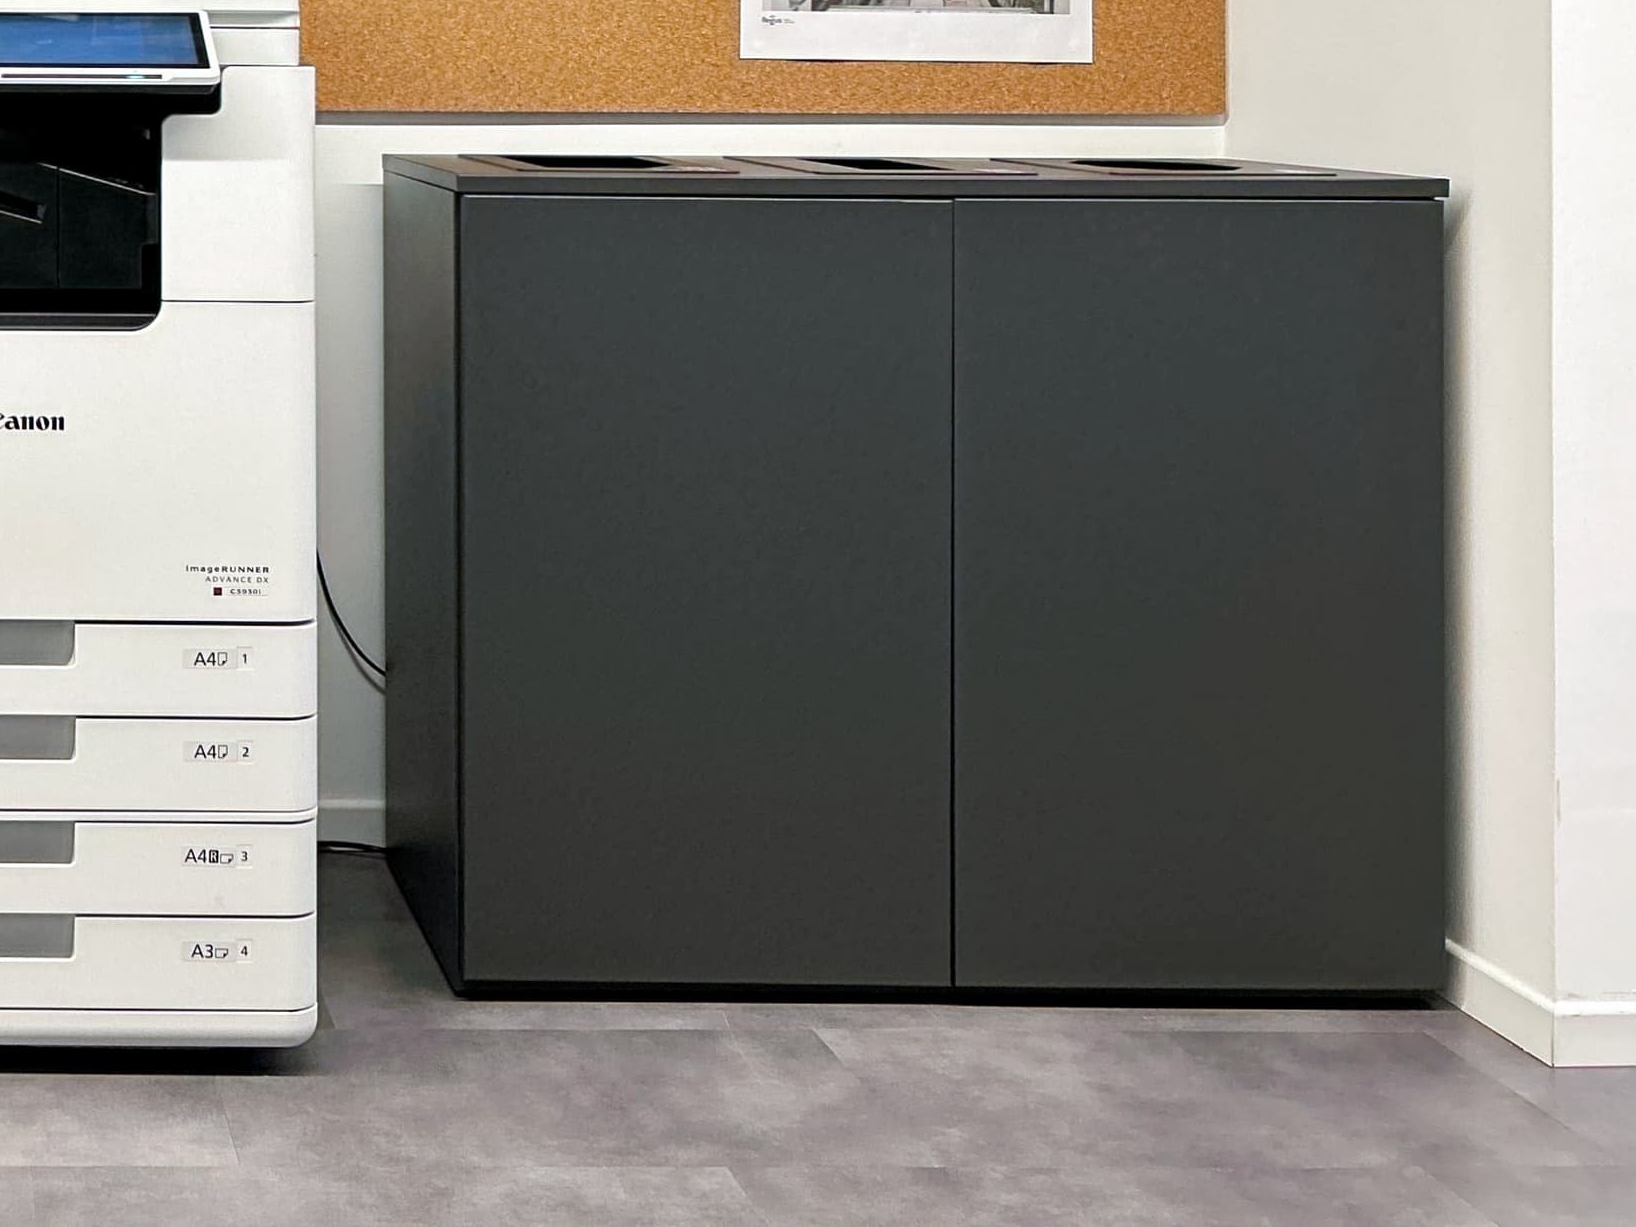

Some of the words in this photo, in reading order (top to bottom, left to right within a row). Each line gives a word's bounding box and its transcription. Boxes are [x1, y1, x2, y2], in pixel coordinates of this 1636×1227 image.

[194, 652, 216, 666] A4
[242, 654, 248, 664] 1
[194, 744, 216, 759] A4
[242, 746, 249, 757] 2
[241, 851, 248, 862] 3
[191, 944, 214, 959] A3
[240, 945, 248, 956] 4
